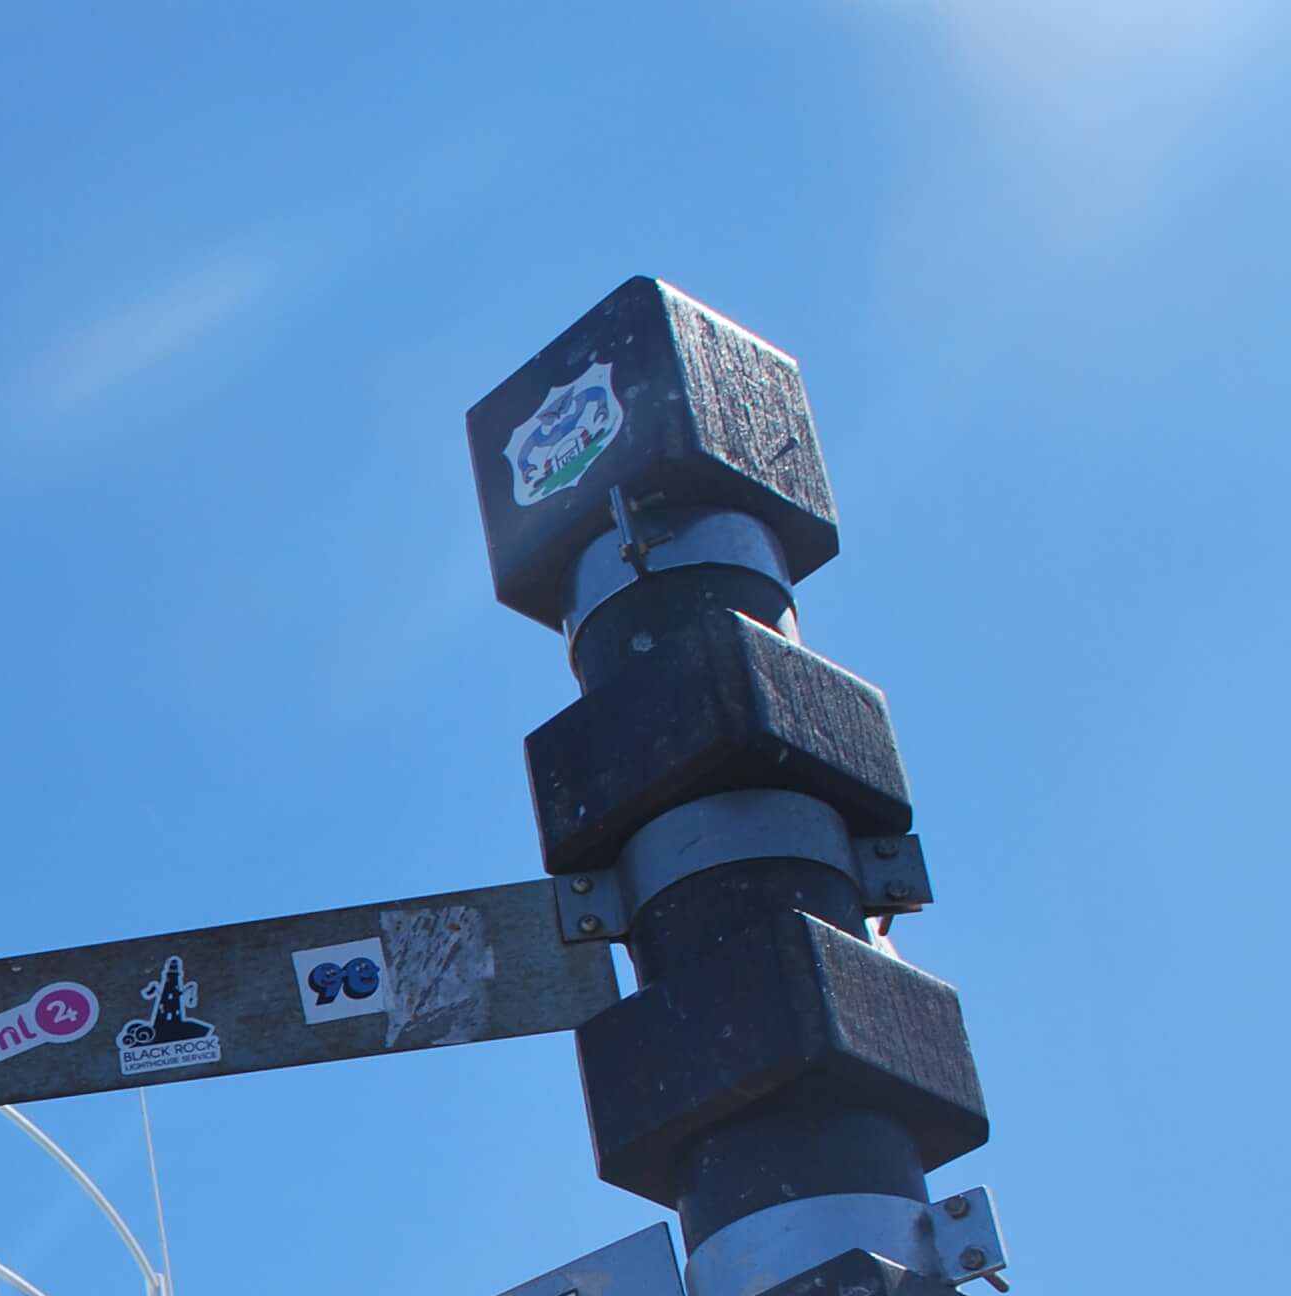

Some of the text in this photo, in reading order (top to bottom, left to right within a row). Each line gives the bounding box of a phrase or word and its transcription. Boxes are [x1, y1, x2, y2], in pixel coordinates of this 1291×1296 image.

[123, 1040, 216, 1062] BLACK ROCK
[125, 1051, 216, 1071] LIGHTHOUSE SERVICE
